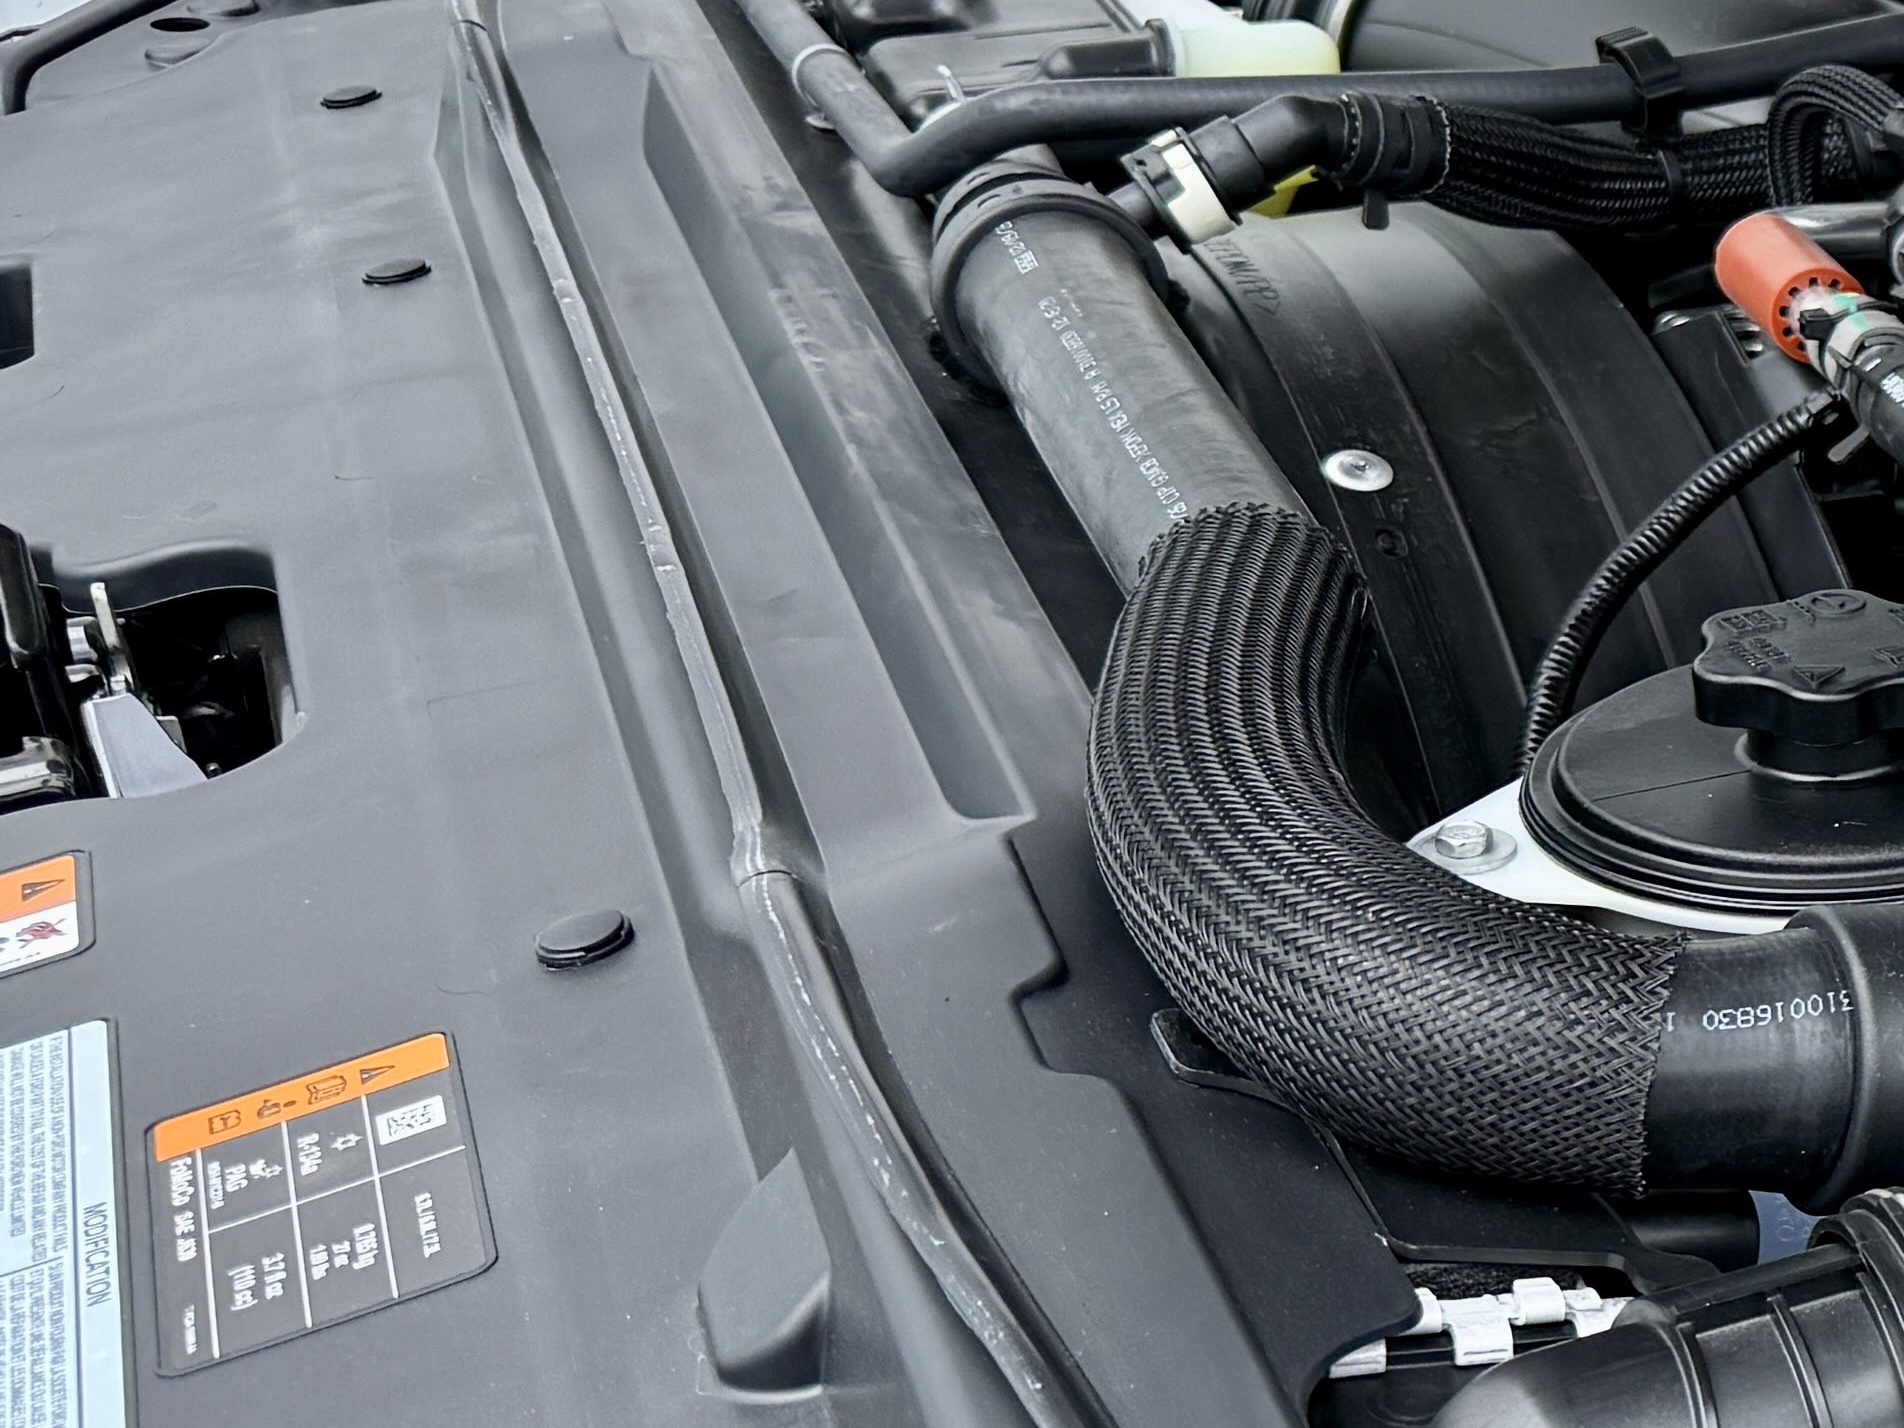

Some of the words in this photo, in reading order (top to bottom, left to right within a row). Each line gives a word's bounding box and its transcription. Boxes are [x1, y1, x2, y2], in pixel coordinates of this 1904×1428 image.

[168, 1156, 194, 1207] FoMoCo
[223, 1163, 248, 1192] PAG
[82, 1201, 111, 1307] MODIFICATION
